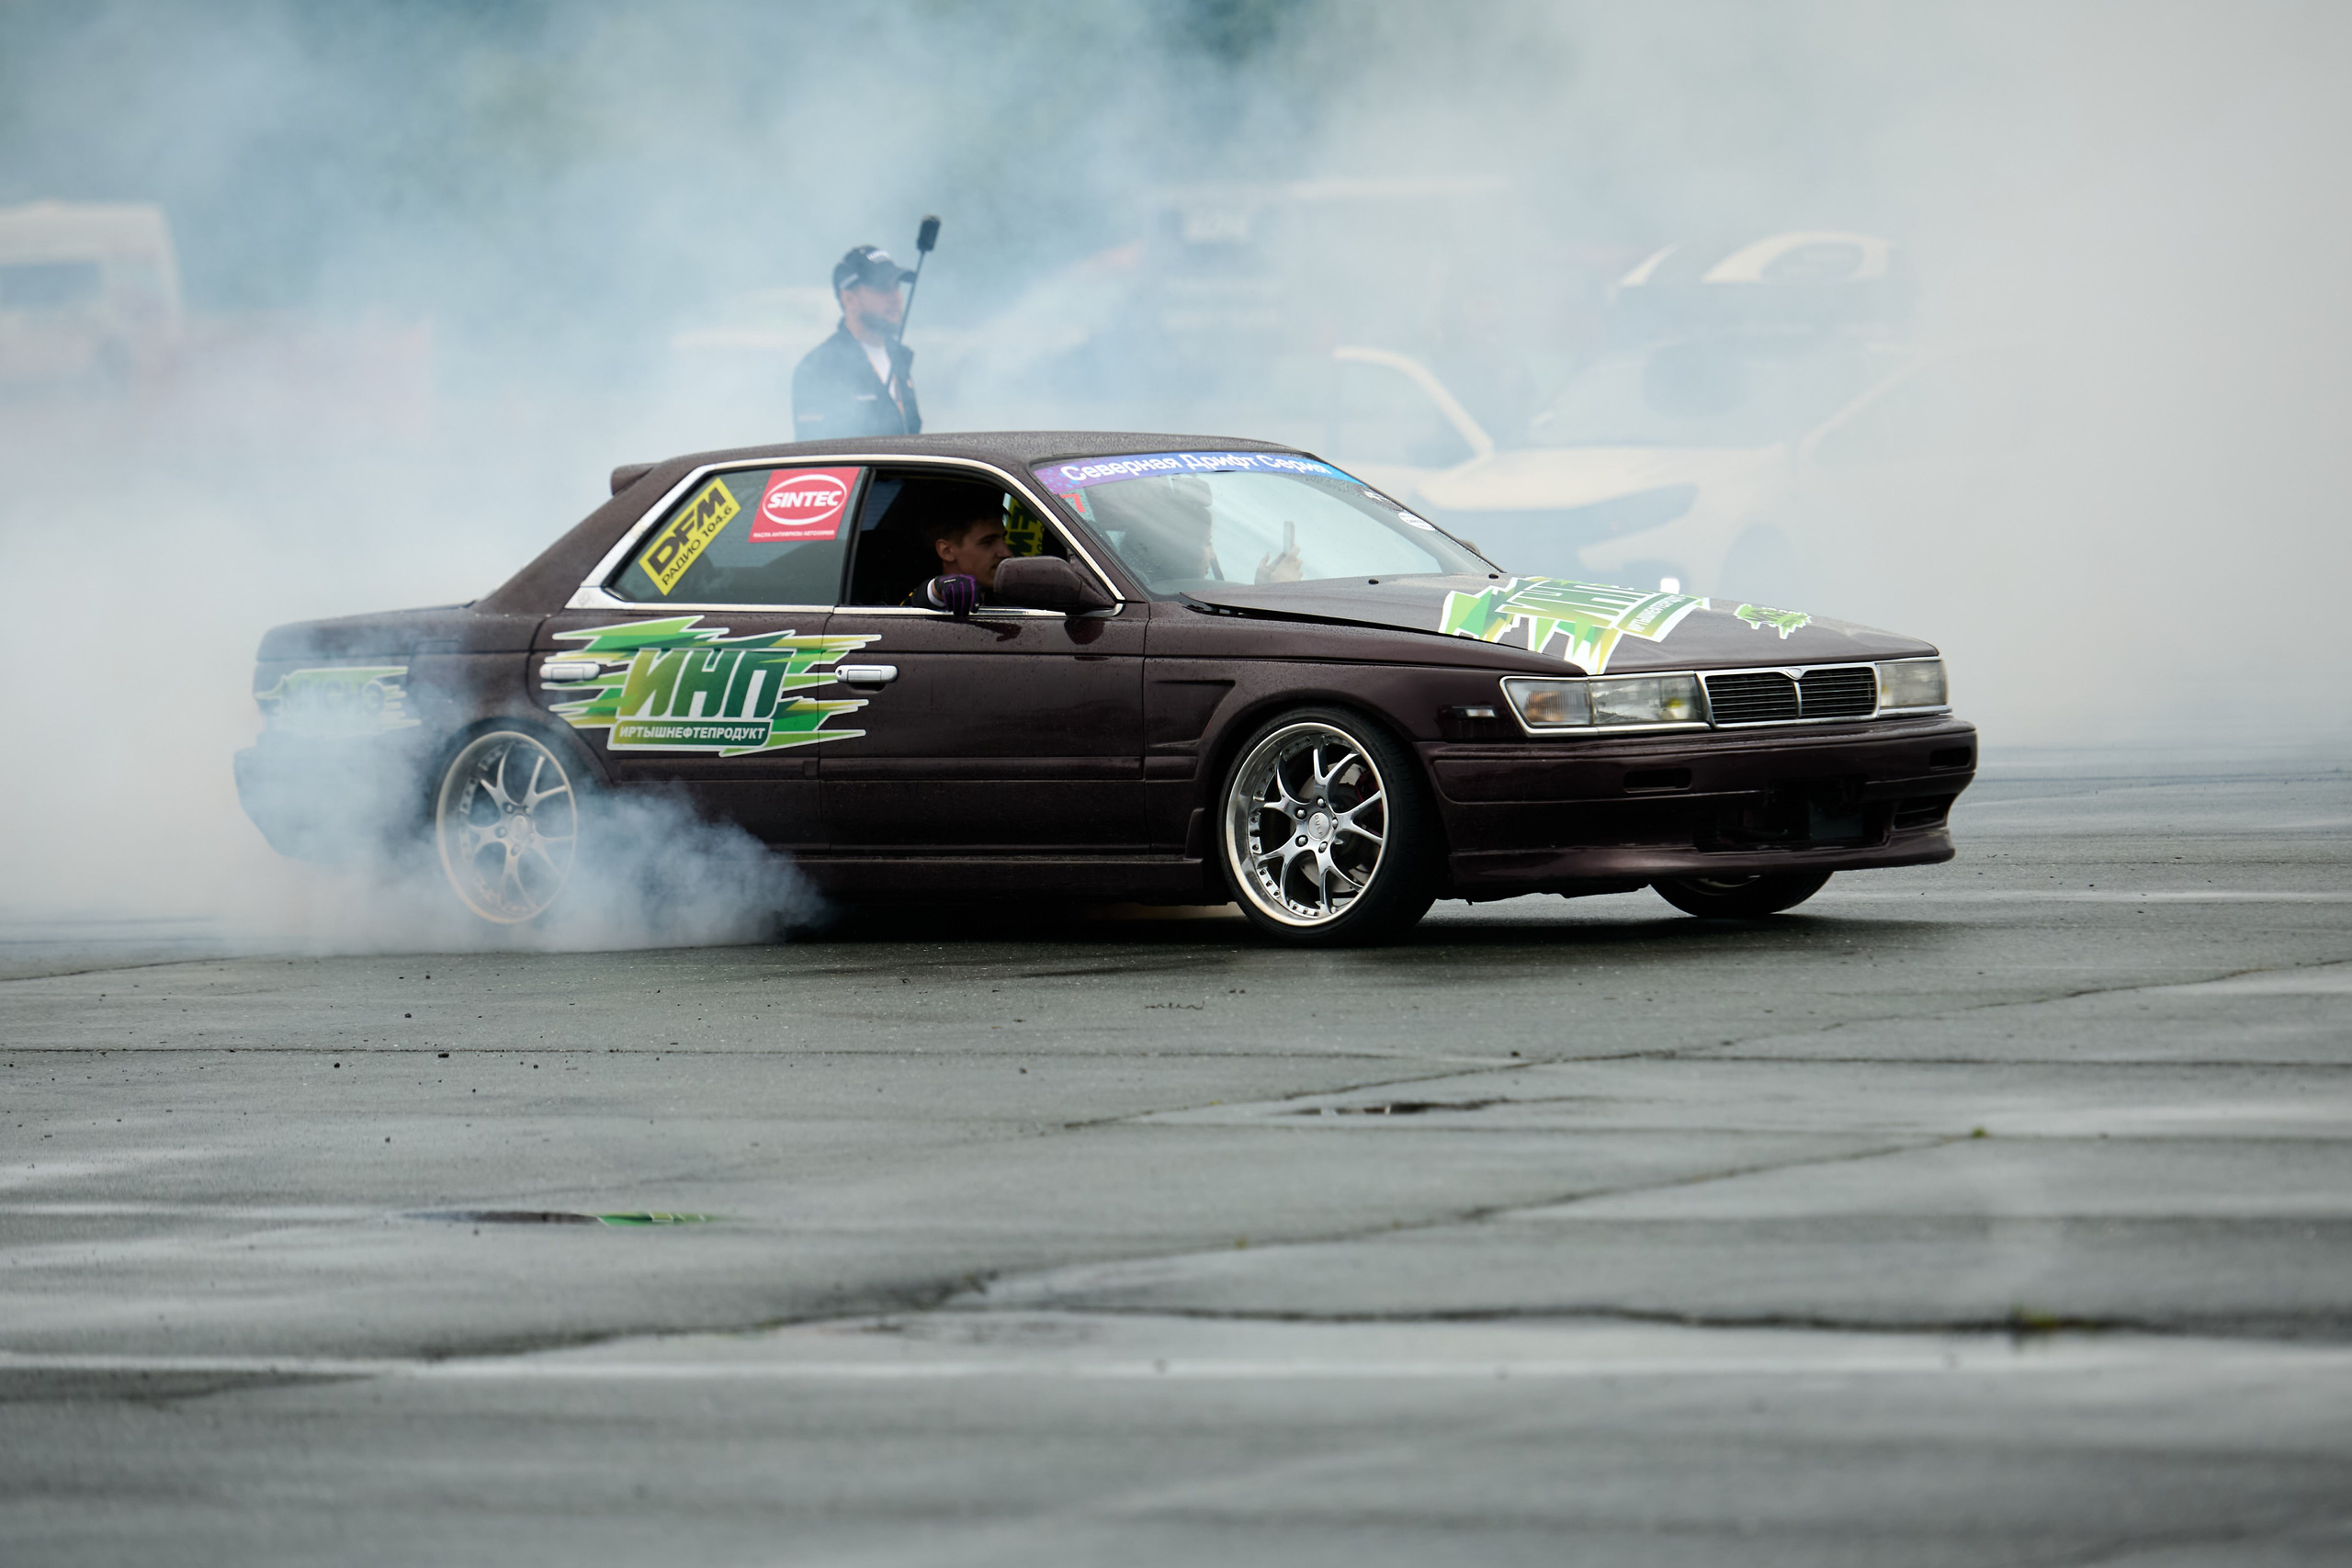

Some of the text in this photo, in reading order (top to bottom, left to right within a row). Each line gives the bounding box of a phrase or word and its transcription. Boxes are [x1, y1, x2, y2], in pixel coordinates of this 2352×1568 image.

[1060, 454, 1331, 481] Северная Дрифт Серия
[767, 490, 843, 509] SINTEC
[647, 487, 727, 577] DFM
[662, 506, 733, 586] РАДИО 104.6
[618, 650, 796, 719] ИНП
[619, 726, 766, 742] ИРТЫШНЕФТЕПРОДУКТ
